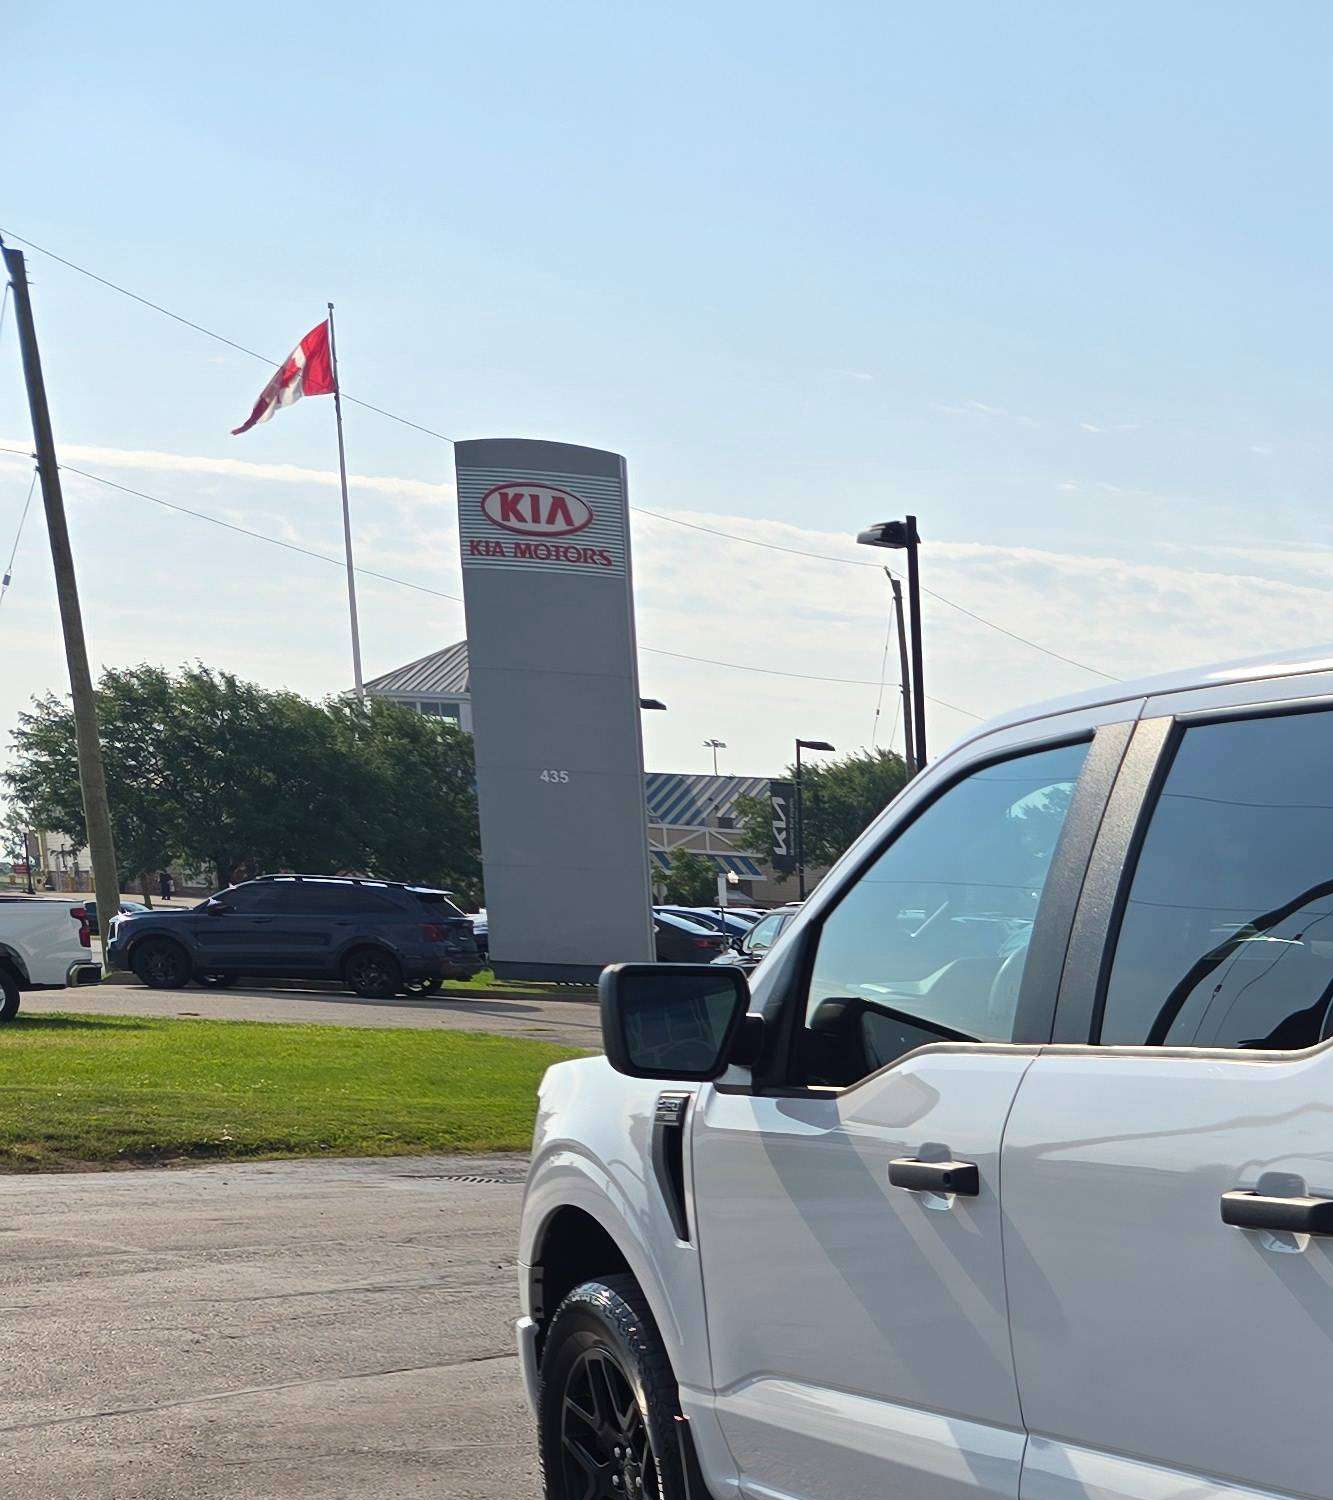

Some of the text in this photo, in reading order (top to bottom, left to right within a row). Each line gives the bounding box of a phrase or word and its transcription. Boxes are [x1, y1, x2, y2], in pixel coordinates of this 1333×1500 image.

[497, 491, 575, 527] KIA
[469, 539, 613, 567] KIA MOTORS
[540, 769, 569, 784] 435
